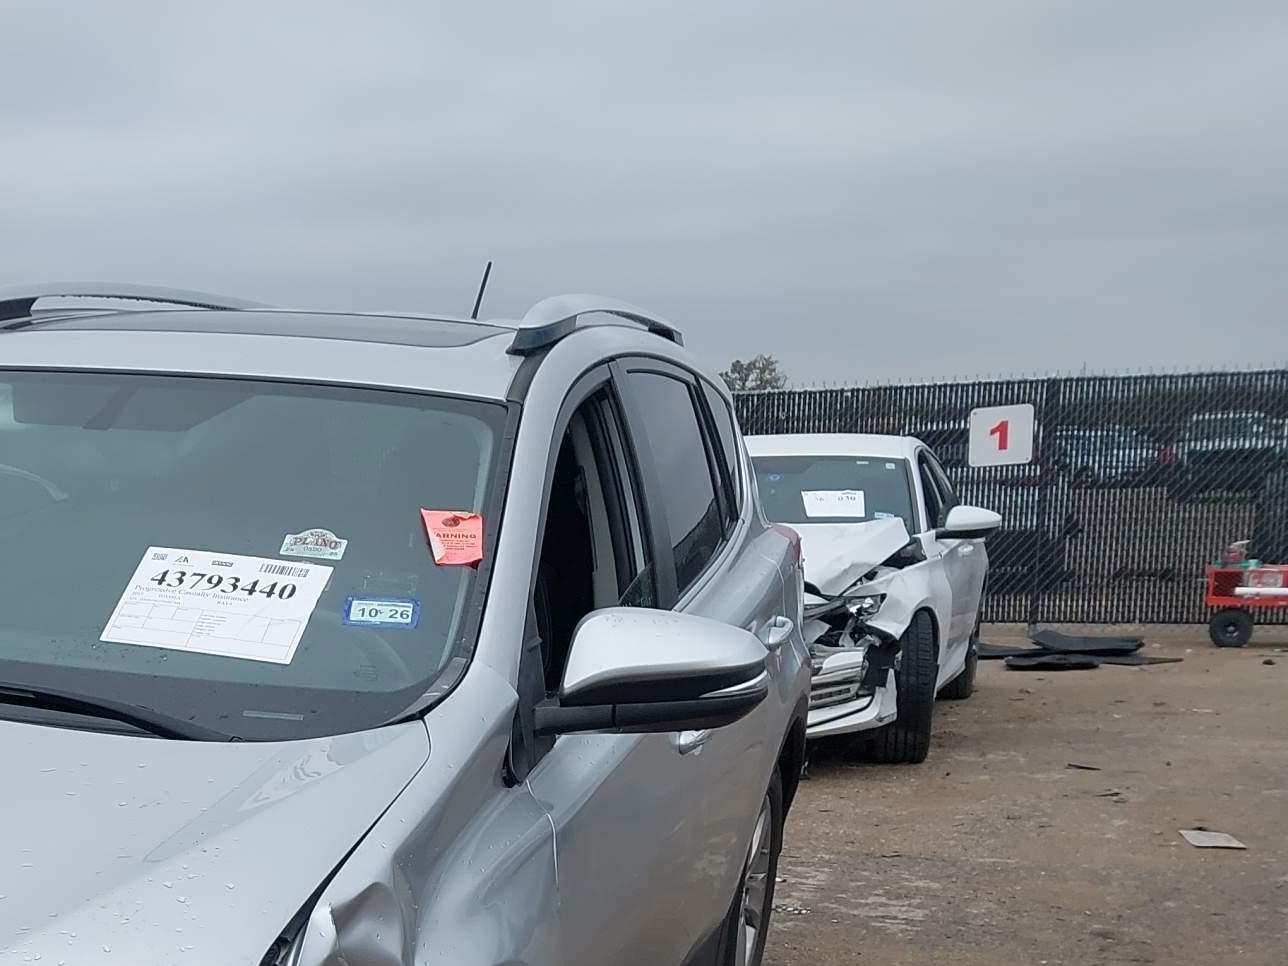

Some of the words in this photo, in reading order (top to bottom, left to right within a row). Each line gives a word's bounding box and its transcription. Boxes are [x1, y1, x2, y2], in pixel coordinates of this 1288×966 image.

[989, 420, 1009, 451] 1
[434, 531, 477, 539] ARNING
[134, 584, 177, 594] Progressive
[178, 588, 210, 598] Casualty
[212, 592, 249, 602] Insurance
[150, 568, 297, 600] 43793440
[358, 607, 379, 618] 10
[388, 608, 410, 619] 26
